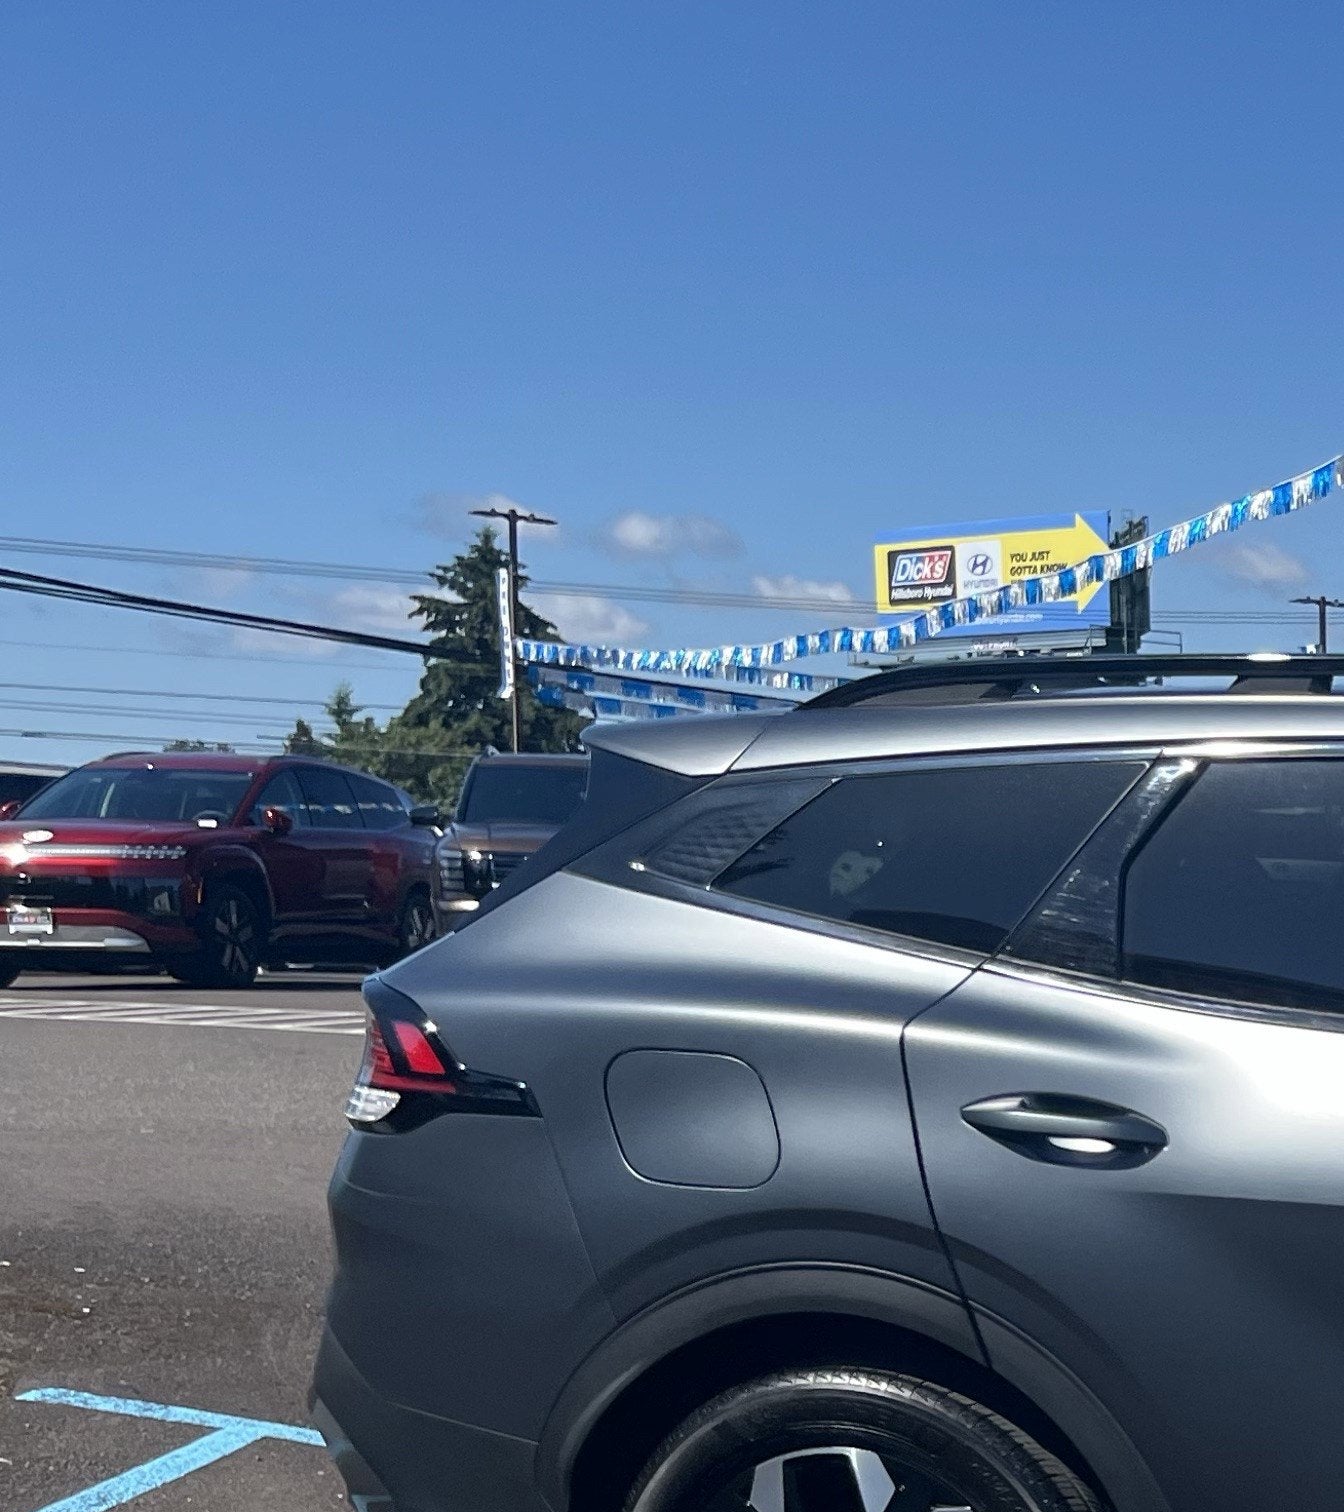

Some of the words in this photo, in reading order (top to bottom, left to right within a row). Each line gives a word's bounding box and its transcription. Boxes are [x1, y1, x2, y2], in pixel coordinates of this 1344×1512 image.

[1010, 552, 1028, 562] YOU
[1029, 550, 1051, 562] JUST
[1010, 565, 1039, 576] GOTTA
